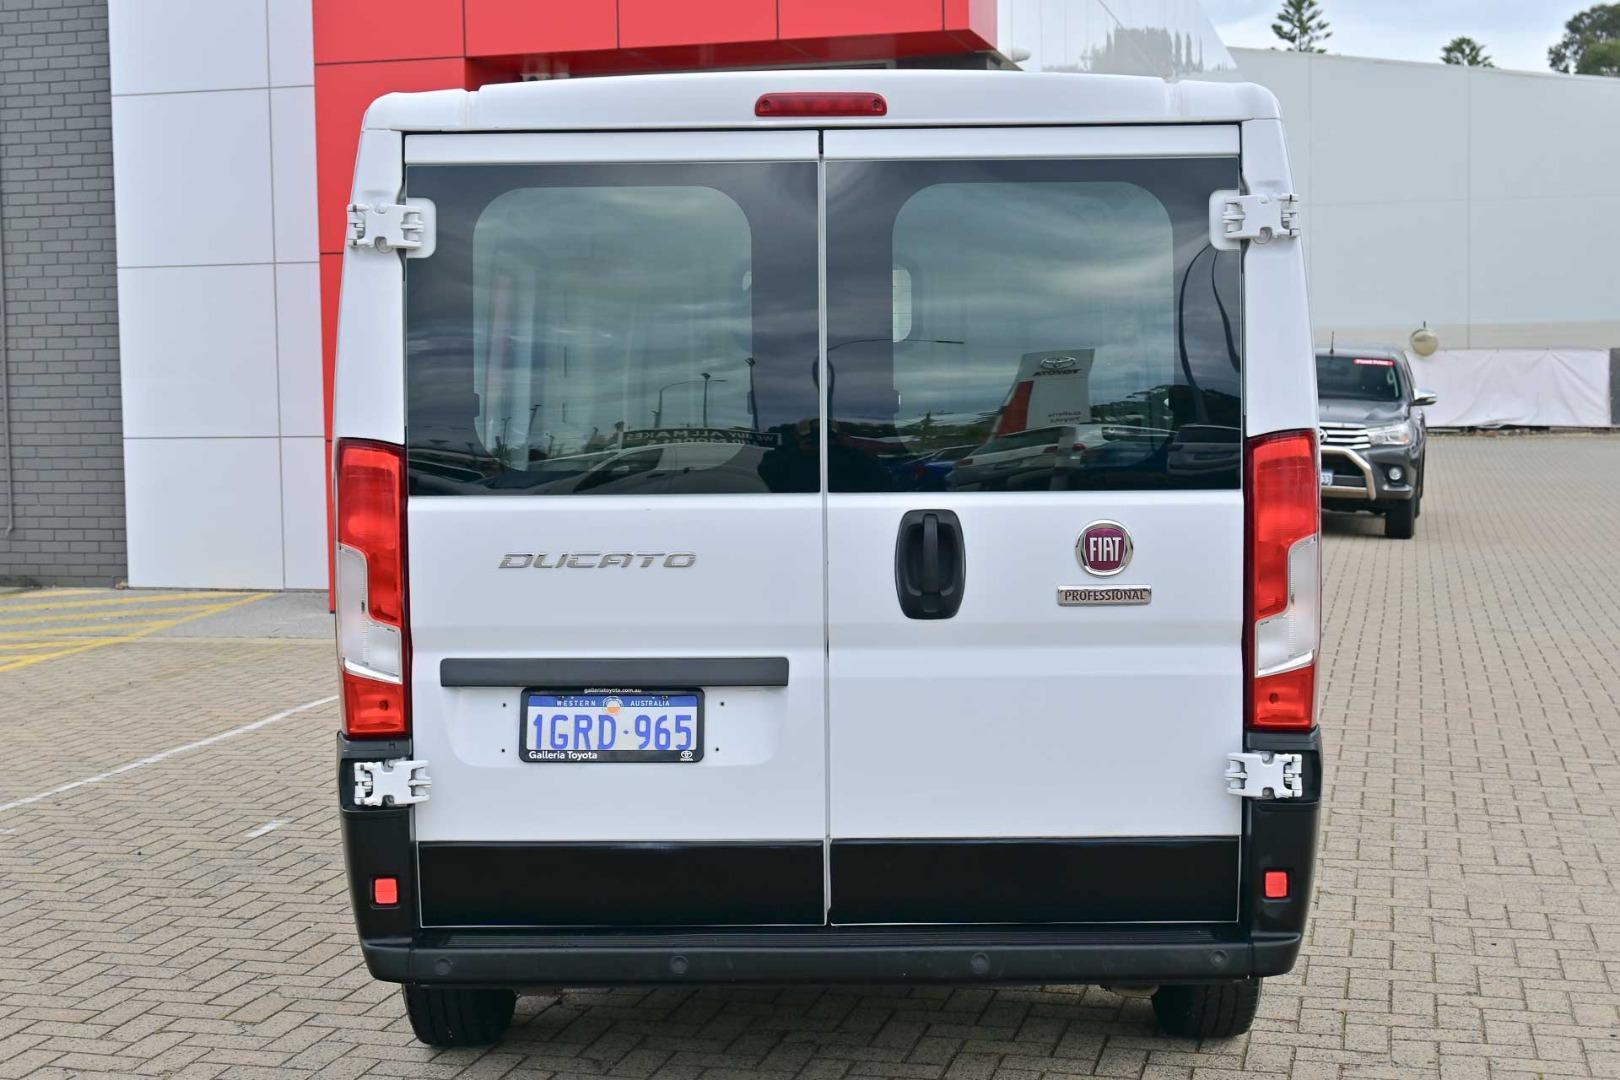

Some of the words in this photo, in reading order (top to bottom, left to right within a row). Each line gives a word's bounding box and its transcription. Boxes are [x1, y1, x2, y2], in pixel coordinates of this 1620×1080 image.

[1089, 537, 1122, 562] FIAT
[498, 552, 697, 569] DUCATO
[1064, 590, 1146, 601] PROFESSIONAL
[528, 751, 566, 759] Galleria
[567, 751, 598, 761] Toyota
